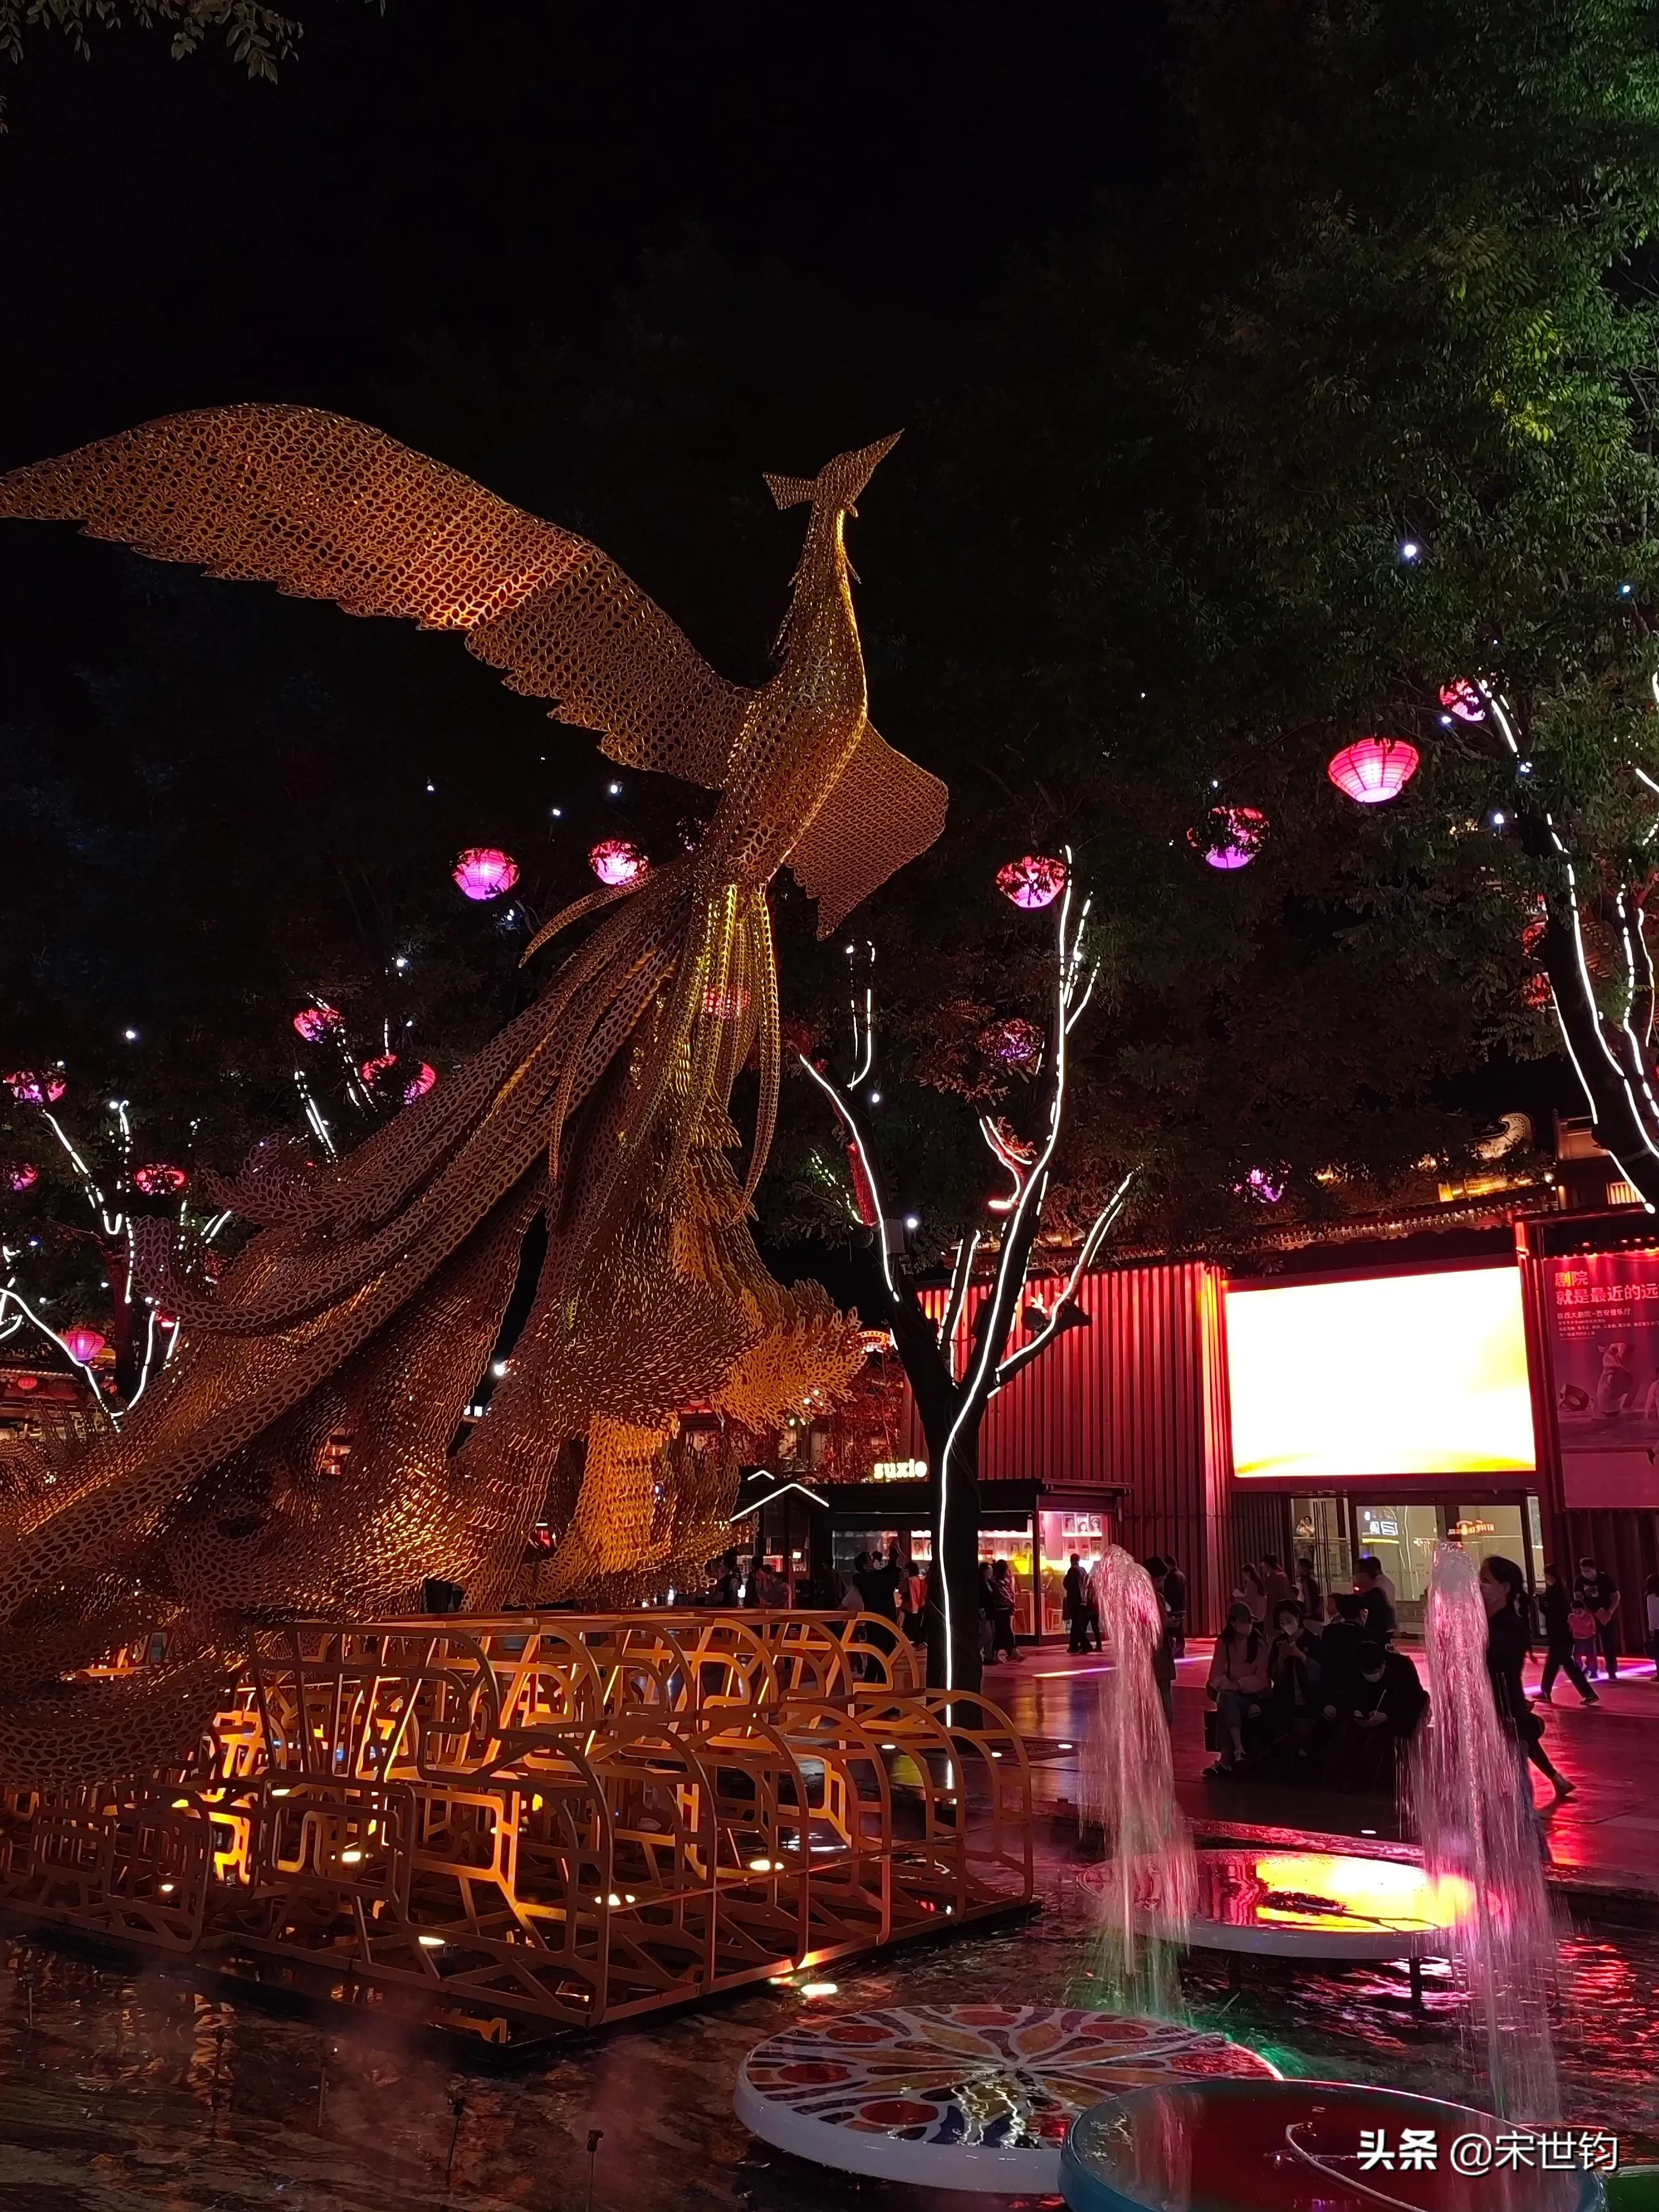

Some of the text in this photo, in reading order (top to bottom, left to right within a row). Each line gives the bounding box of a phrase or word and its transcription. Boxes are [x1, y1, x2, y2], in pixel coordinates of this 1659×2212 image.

[1555, 1270, 1589, 1287] 剧院
[1555, 1283, 1659, 1305] 就是最近的远
